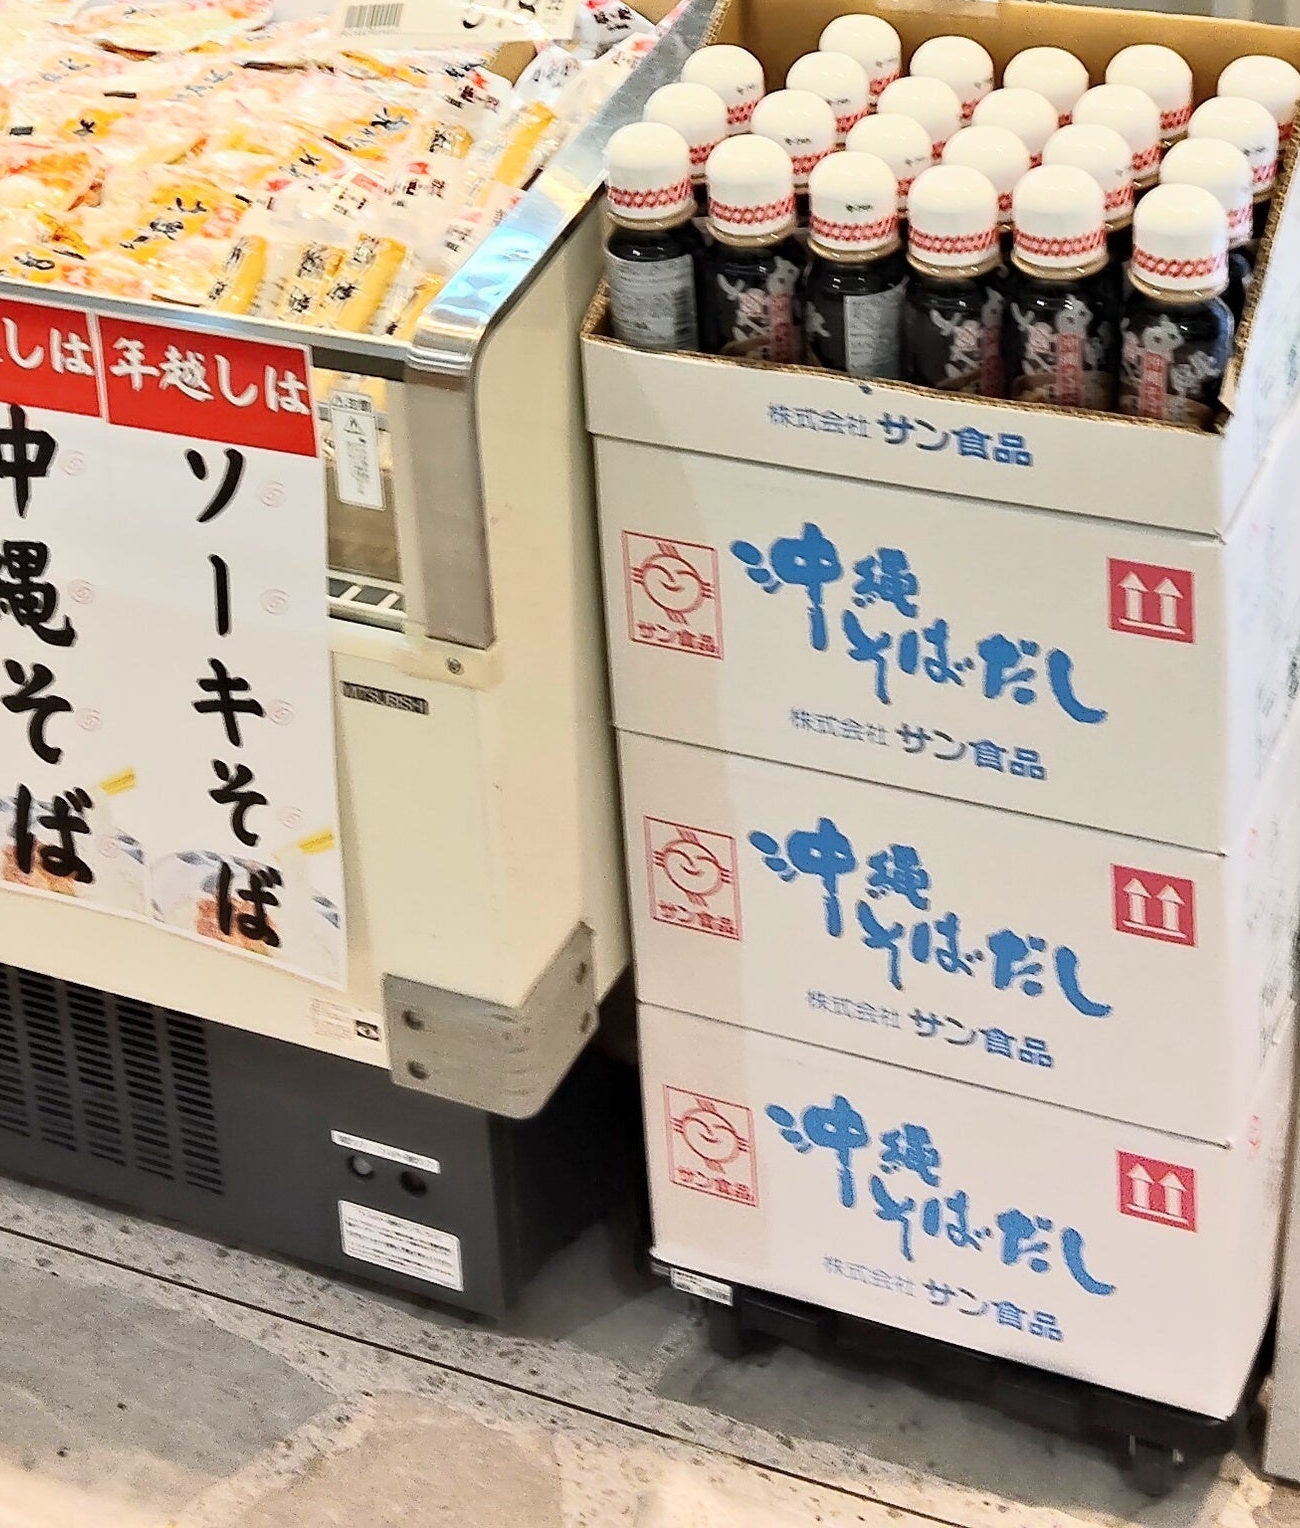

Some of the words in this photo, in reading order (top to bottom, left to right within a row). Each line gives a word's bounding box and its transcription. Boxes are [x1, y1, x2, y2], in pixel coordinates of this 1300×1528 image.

[109, 336, 313, 417] 年越しは
[766, 402, 873, 442] 株式会社
[874, 410, 1034, 468] サン食品
[636, 621, 720, 657] サン食品
[184, 447, 284, 949] ソーキそば
[790, 707, 891, 747] 株式会社
[896, 721, 1049, 781] サン食品
[659, 900, 737, 937] サン食品
[805, 987, 902, 1030] 株式会社
[908, 1007, 1056, 1070] サン食品
[677, 1166, 756, 1204] サン食品
[822, 1253, 916, 1299] 株式会社
[923, 1278, 1065, 1342] サン食品
